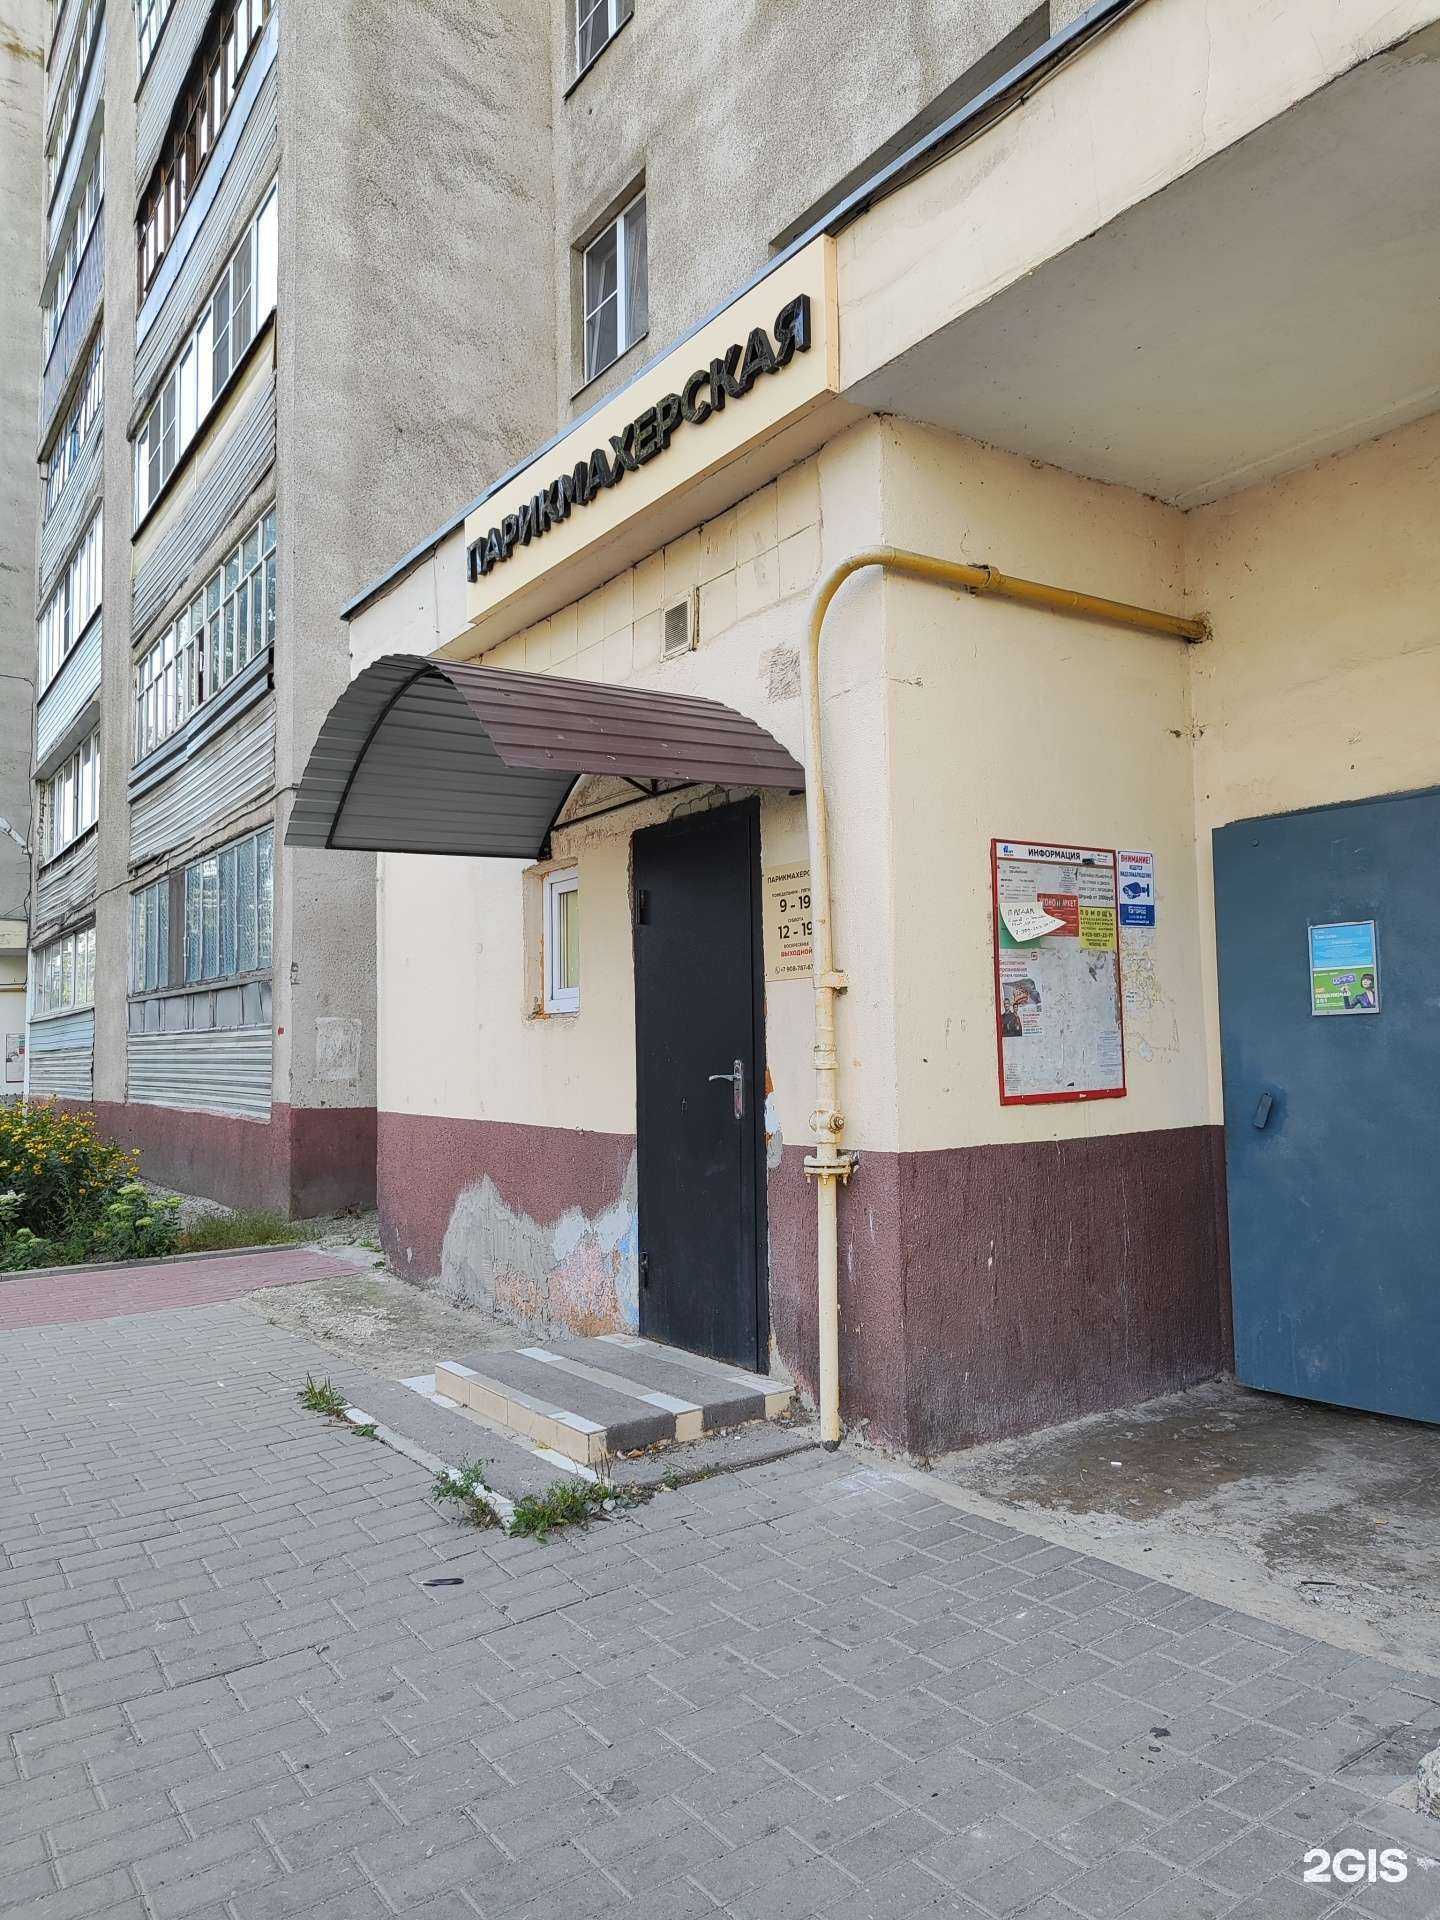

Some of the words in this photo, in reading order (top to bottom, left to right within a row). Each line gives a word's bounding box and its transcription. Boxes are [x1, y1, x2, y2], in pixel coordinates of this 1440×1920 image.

[467, 293, 811, 583] ПАРИКМАХЕРСКАЯ
[1028, 848, 1081, 861] ИНФОРМАЦИЯ
[1120, 854, 1151, 864] ВНИМАНИЕ!
[779, 898, 788, 913] 9
[798, 894, 811, 909] 19
[777, 924, 790, 940] 12
[801, 920, 812, 937] 19
[780, 946, 813, 957] ВЫХОДНОЙ
